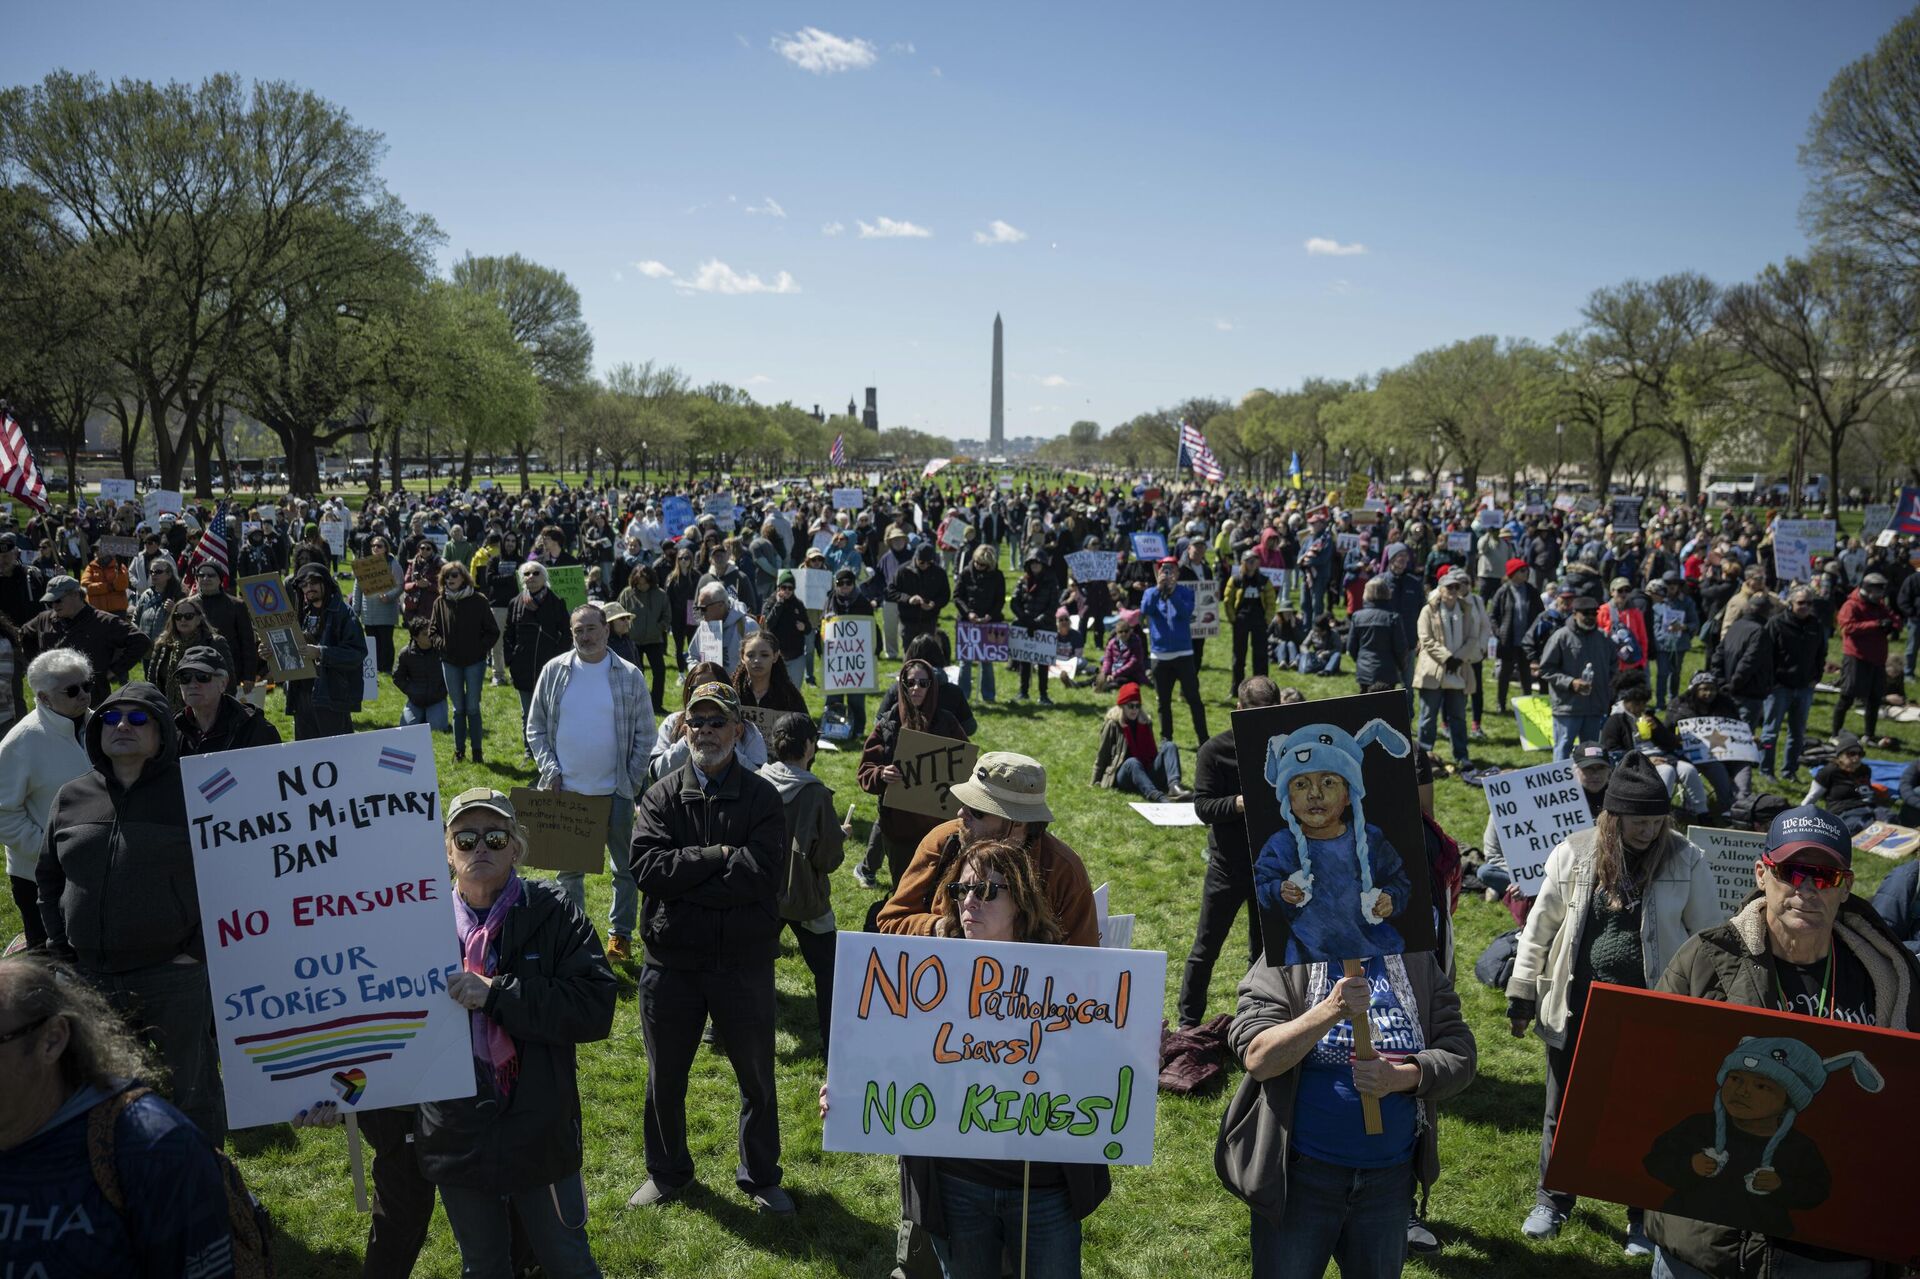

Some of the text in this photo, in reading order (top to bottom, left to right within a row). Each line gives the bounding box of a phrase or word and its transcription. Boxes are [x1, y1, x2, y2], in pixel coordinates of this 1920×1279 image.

[1200, 583, 1216, 592] SHIT
[833, 621, 858, 639] NO
[957, 627, 982, 644] NO
[827, 639, 865, 656] FAUX
[827, 654, 866, 672] KING
[832, 672, 866, 687] WAY
[894, 743, 966, 790] WTF
[277, 761, 338, 801] NO
[1489, 766, 1574, 797] NO KINGS
[1496, 787, 1580, 817] NO WARS
[192, 812, 292, 850] TRANS
[1502, 809, 1586, 839] TAX THE
[1782, 828, 1798, 836] HAVE
[1811, 816, 1841, 836] People
[1710, 835, 1766, 850] Whateve
[271, 835, 339, 878] BAN
[1718, 850, 1756, 863] Allow
[1511, 862, 1547, 884] FUC
[1714, 874, 1730, 886] To
[217, 878, 440, 947] NO ERASURE
[290, 945, 378, 981] OUR
[857, 945, 1132, 1033] NO Pathological
[932, 1020, 1043, 1085] Liars!
[862, 1065, 1134, 1160] NO KINGS!
